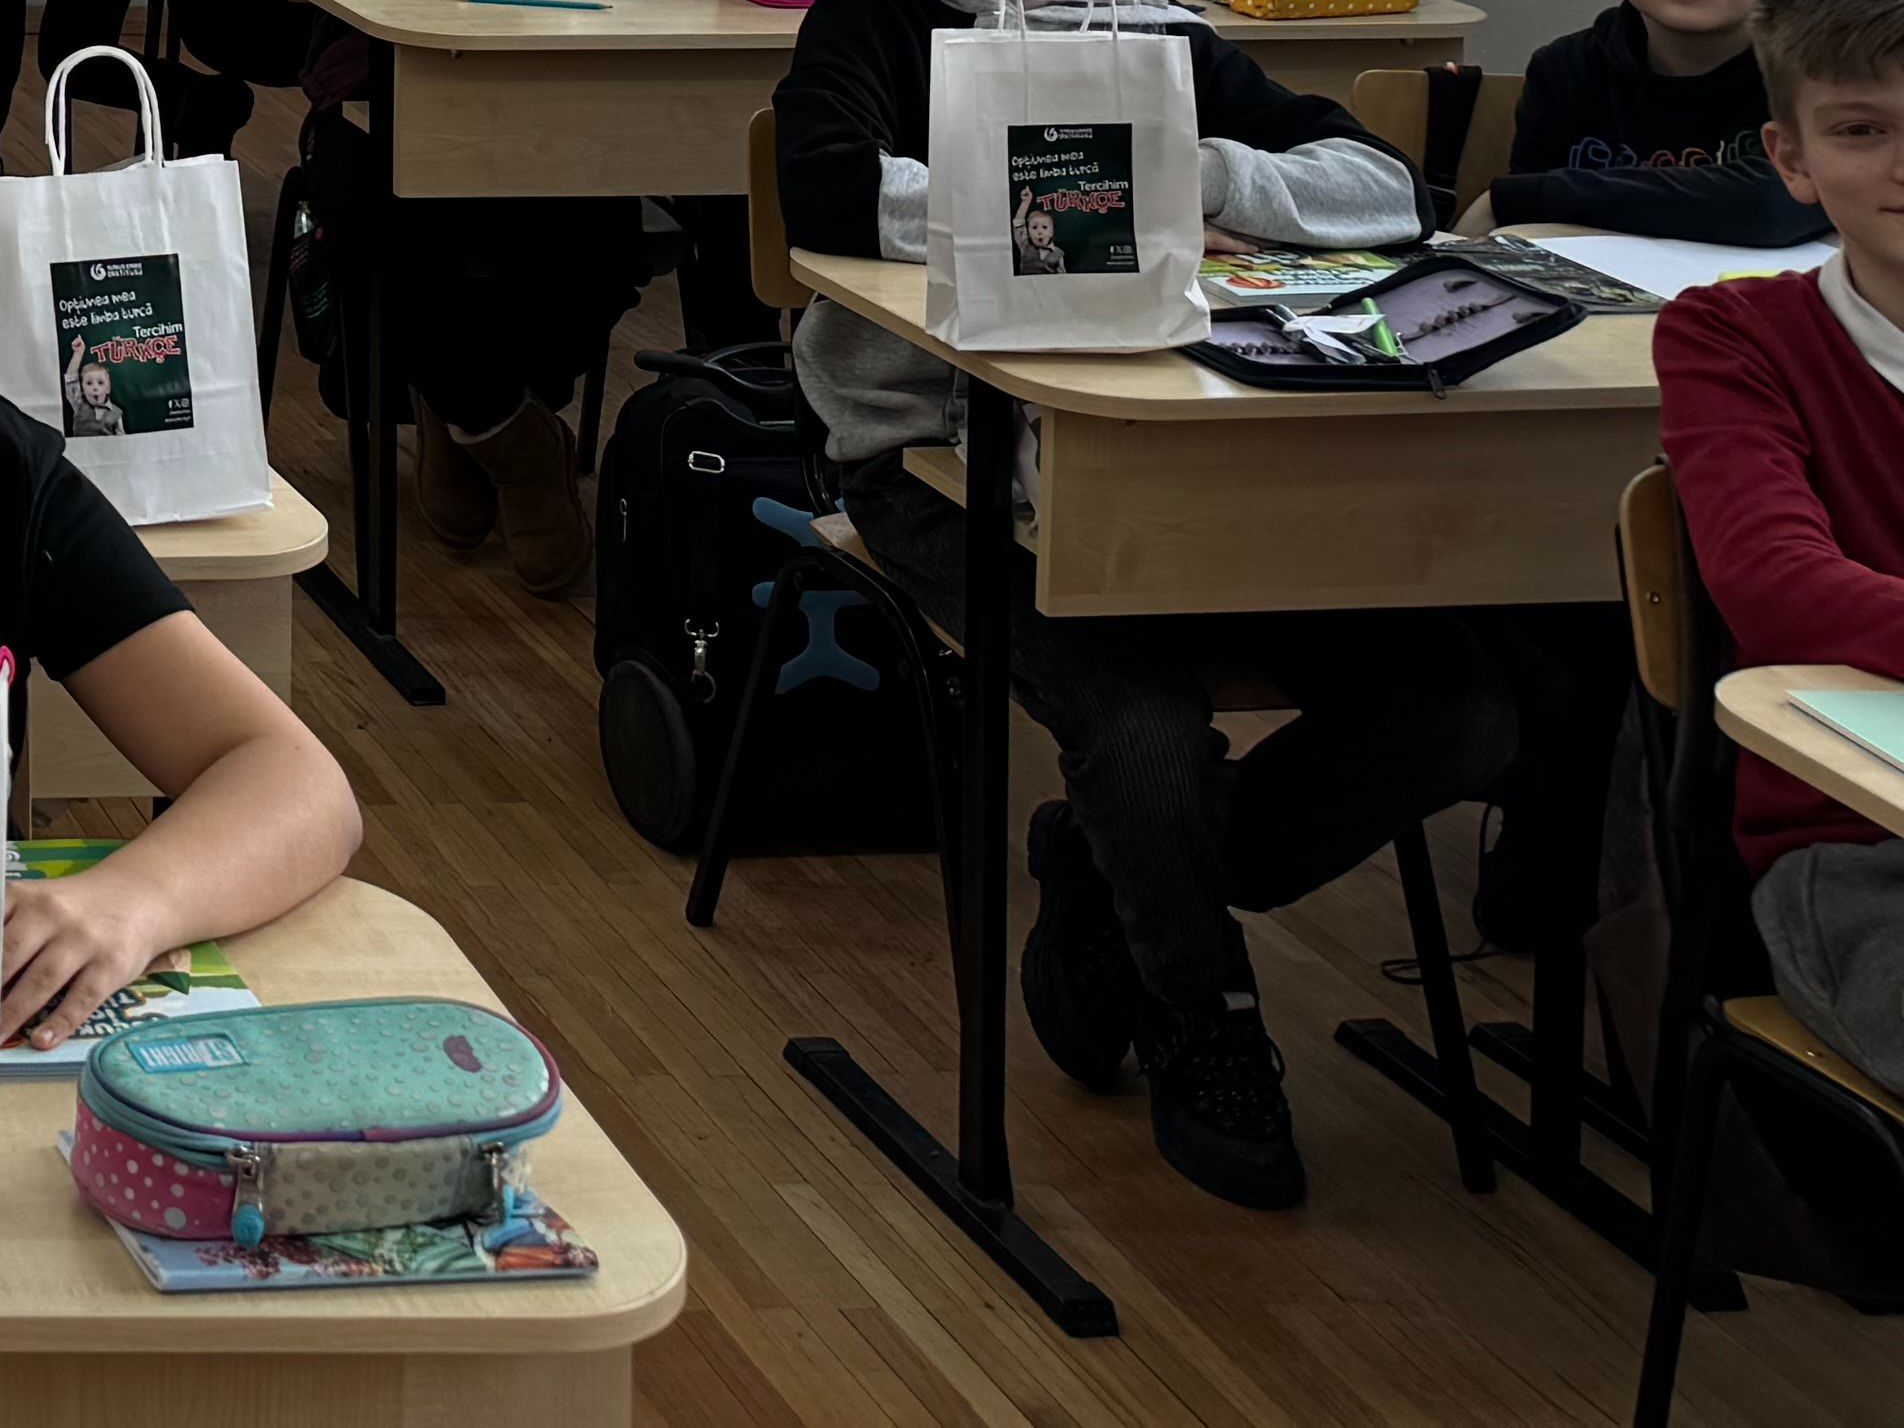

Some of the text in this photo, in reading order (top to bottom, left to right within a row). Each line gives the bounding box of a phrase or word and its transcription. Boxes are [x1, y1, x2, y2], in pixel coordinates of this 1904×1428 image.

[1077, 179, 1129, 191] Tercihim
[133, 322, 183, 338] Tercihim
[90, 335, 181, 364] TÜRKÇE
